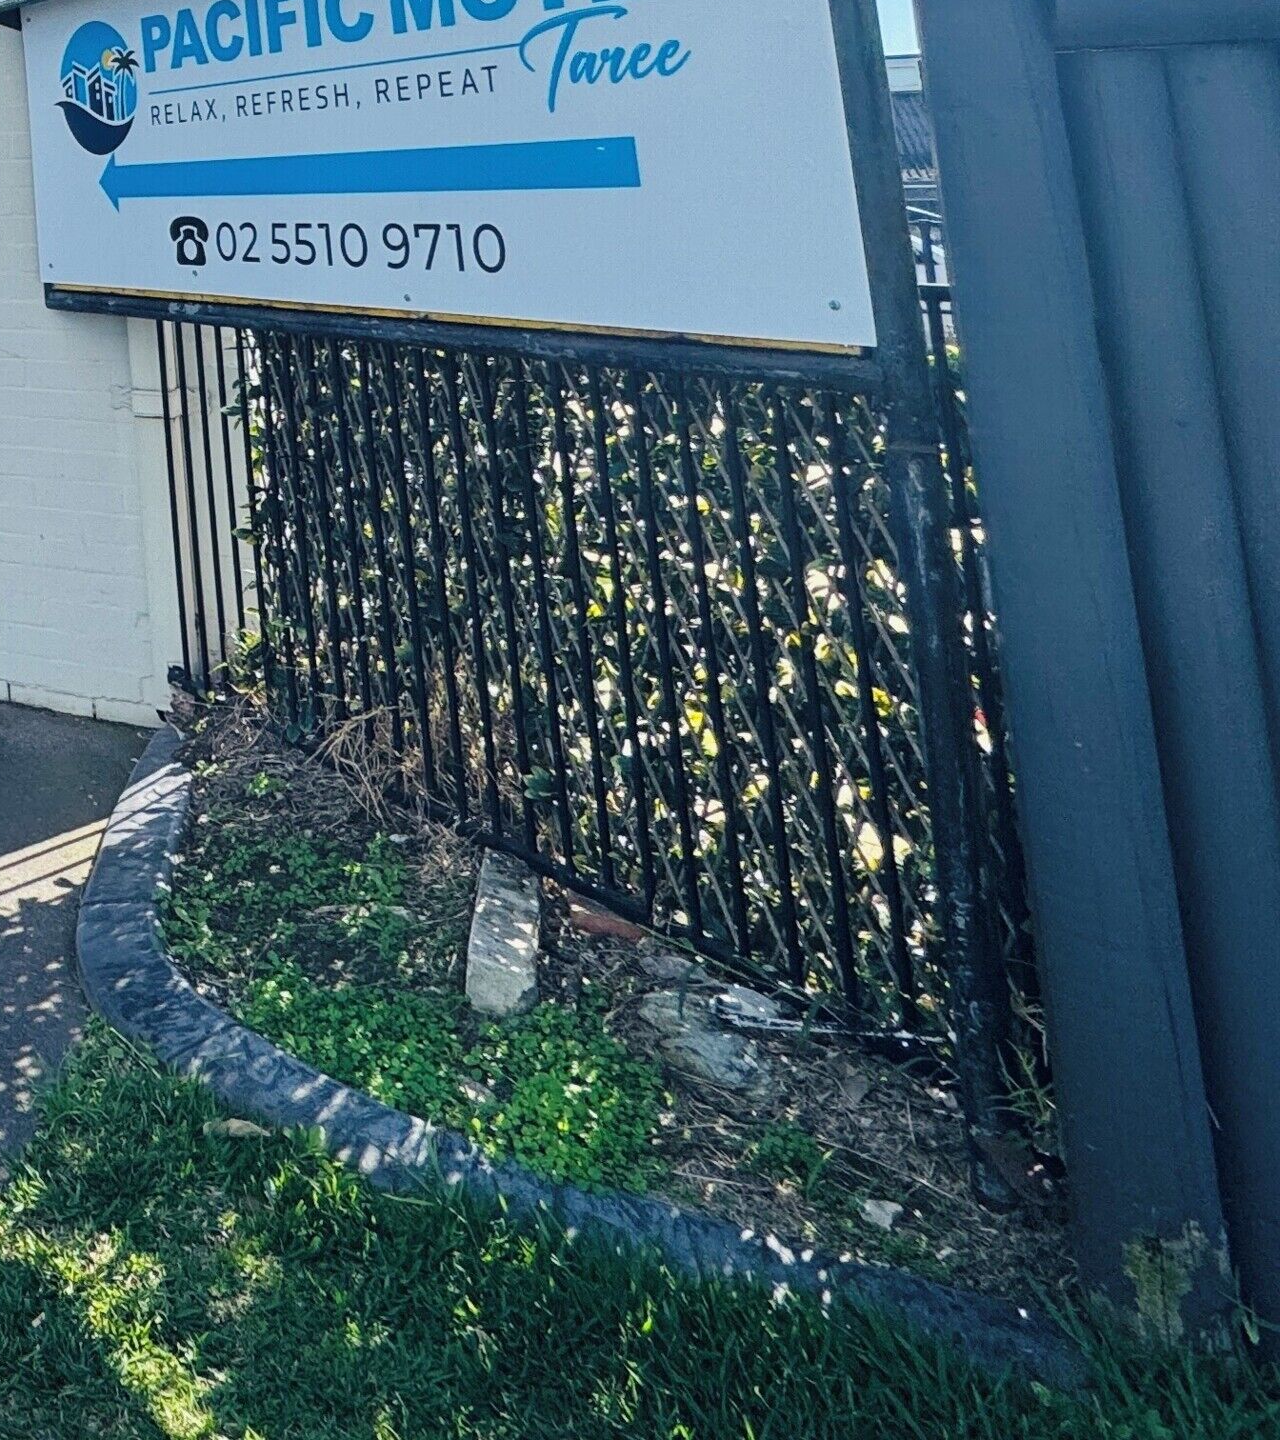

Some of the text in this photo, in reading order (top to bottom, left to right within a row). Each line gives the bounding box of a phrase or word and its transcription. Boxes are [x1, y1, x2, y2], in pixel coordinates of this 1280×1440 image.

[519, 5, 692, 112] Taree
[150, 65, 498, 127] RELAX, REFRESH, REPEAT
[217, 221, 506, 274] 02 5510 9710
